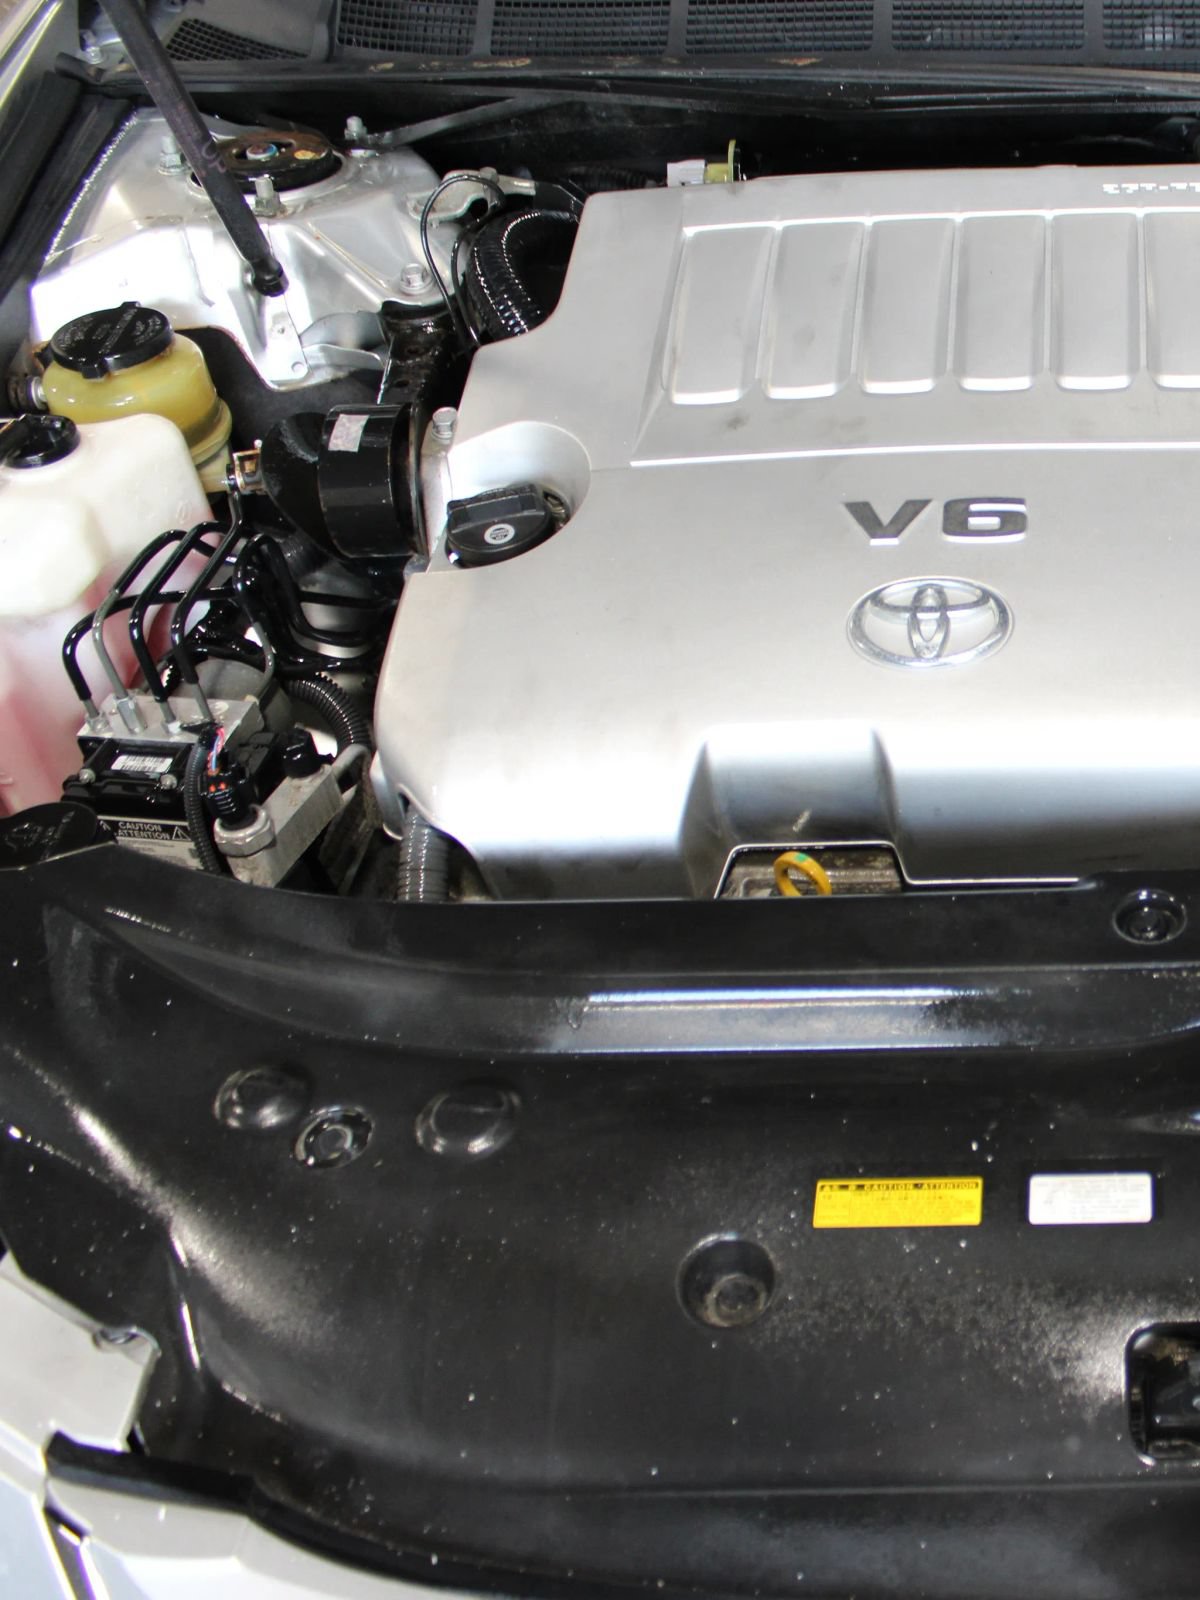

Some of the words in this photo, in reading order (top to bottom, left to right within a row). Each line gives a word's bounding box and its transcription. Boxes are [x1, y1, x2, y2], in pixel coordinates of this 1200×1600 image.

[843, 497, 1028, 546] V6
[118, 821, 163, 832] CAUTION
[117, 829, 171, 840] ATTENTION
